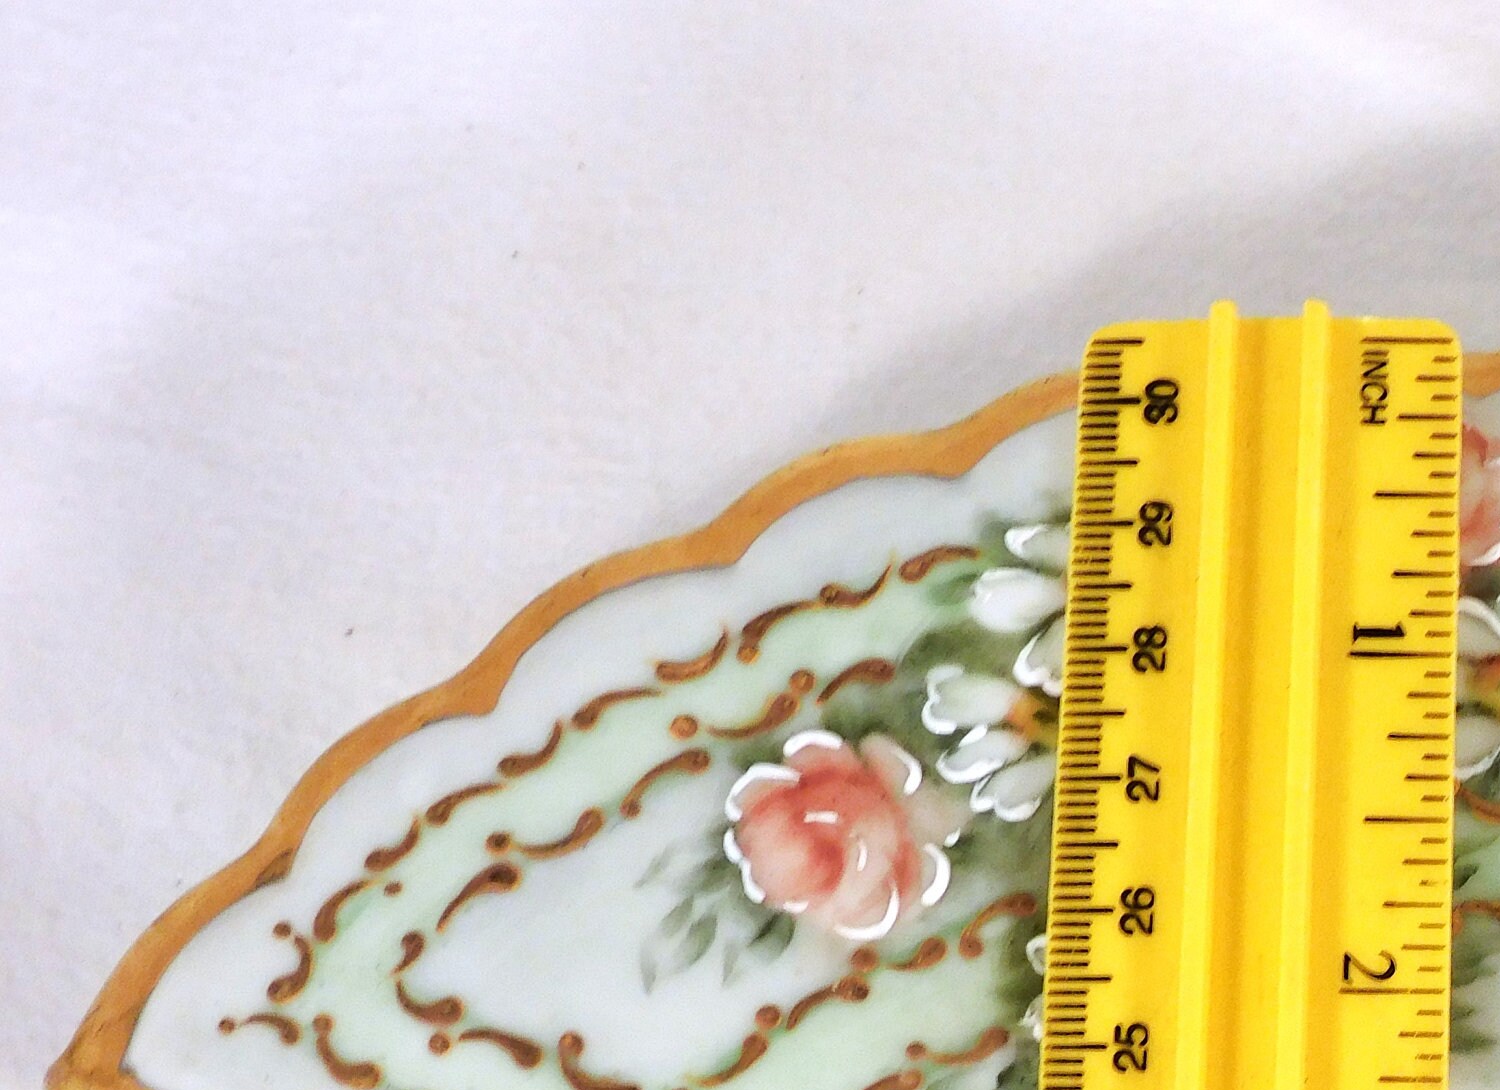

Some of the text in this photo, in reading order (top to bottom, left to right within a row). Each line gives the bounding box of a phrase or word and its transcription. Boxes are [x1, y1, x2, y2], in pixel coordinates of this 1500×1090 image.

[1143, 378, 1180, 425] 30
[1360, 350, 1390, 425] INCH
[1137, 500, 1174, 547] 29
[1131, 624, 1168, 674] 28
[1352, 624, 1406, 644] 1
[1125, 755, 1160, 802] 27
[1118, 886, 1155, 936] 26
[1342, 950, 1397, 983] 2
[1112, 1022, 1149, 1073] 25
